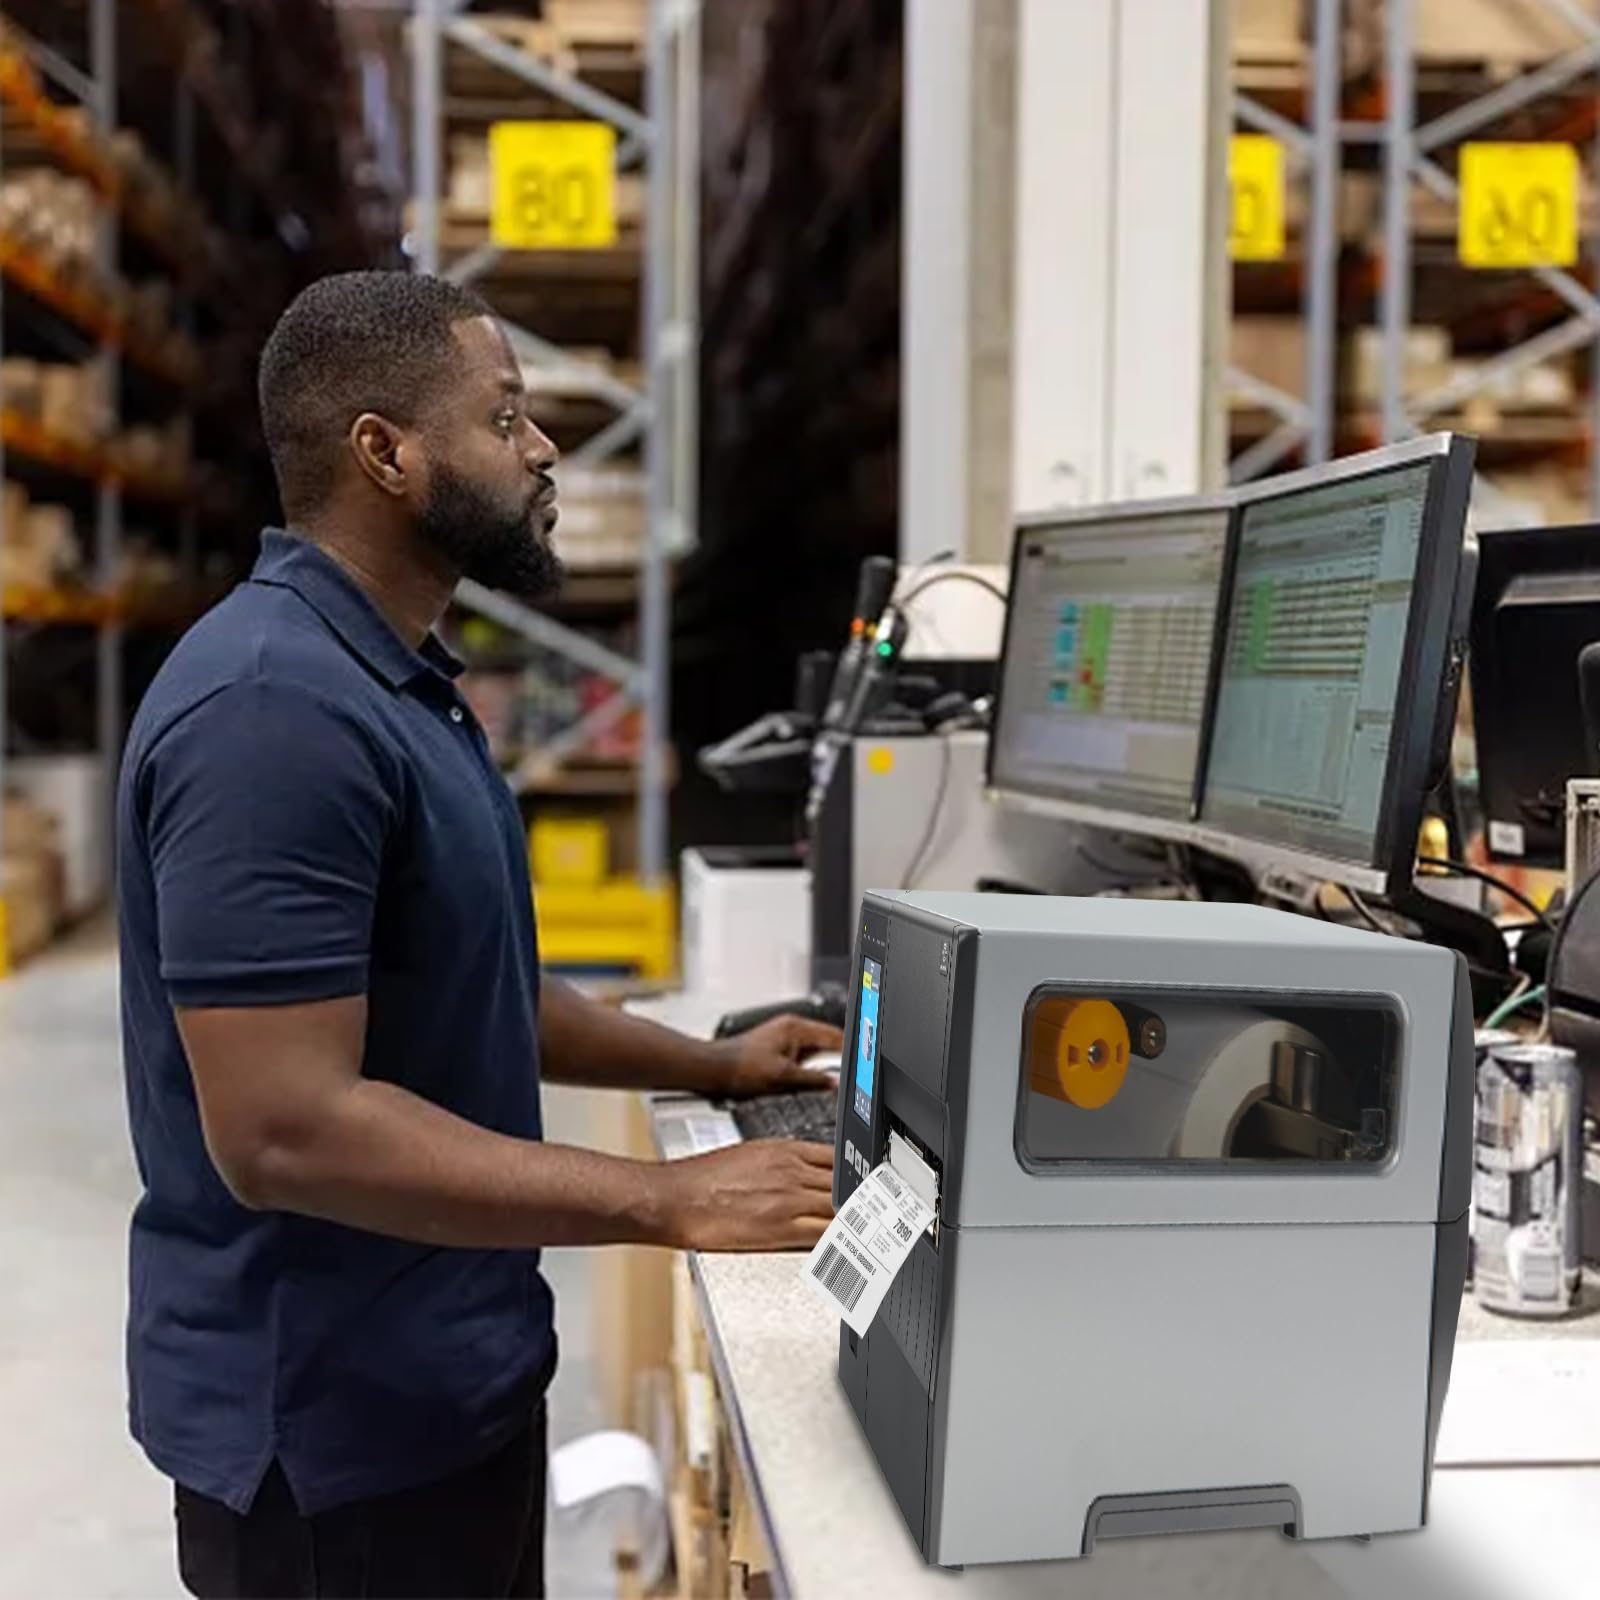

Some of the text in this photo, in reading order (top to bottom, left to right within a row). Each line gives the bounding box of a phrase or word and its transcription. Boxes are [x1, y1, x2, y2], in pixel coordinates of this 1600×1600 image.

[511, 162, 597, 231] 80
[1479, 184, 1558, 247] 60
[892, 1217, 912, 1242] 7890
